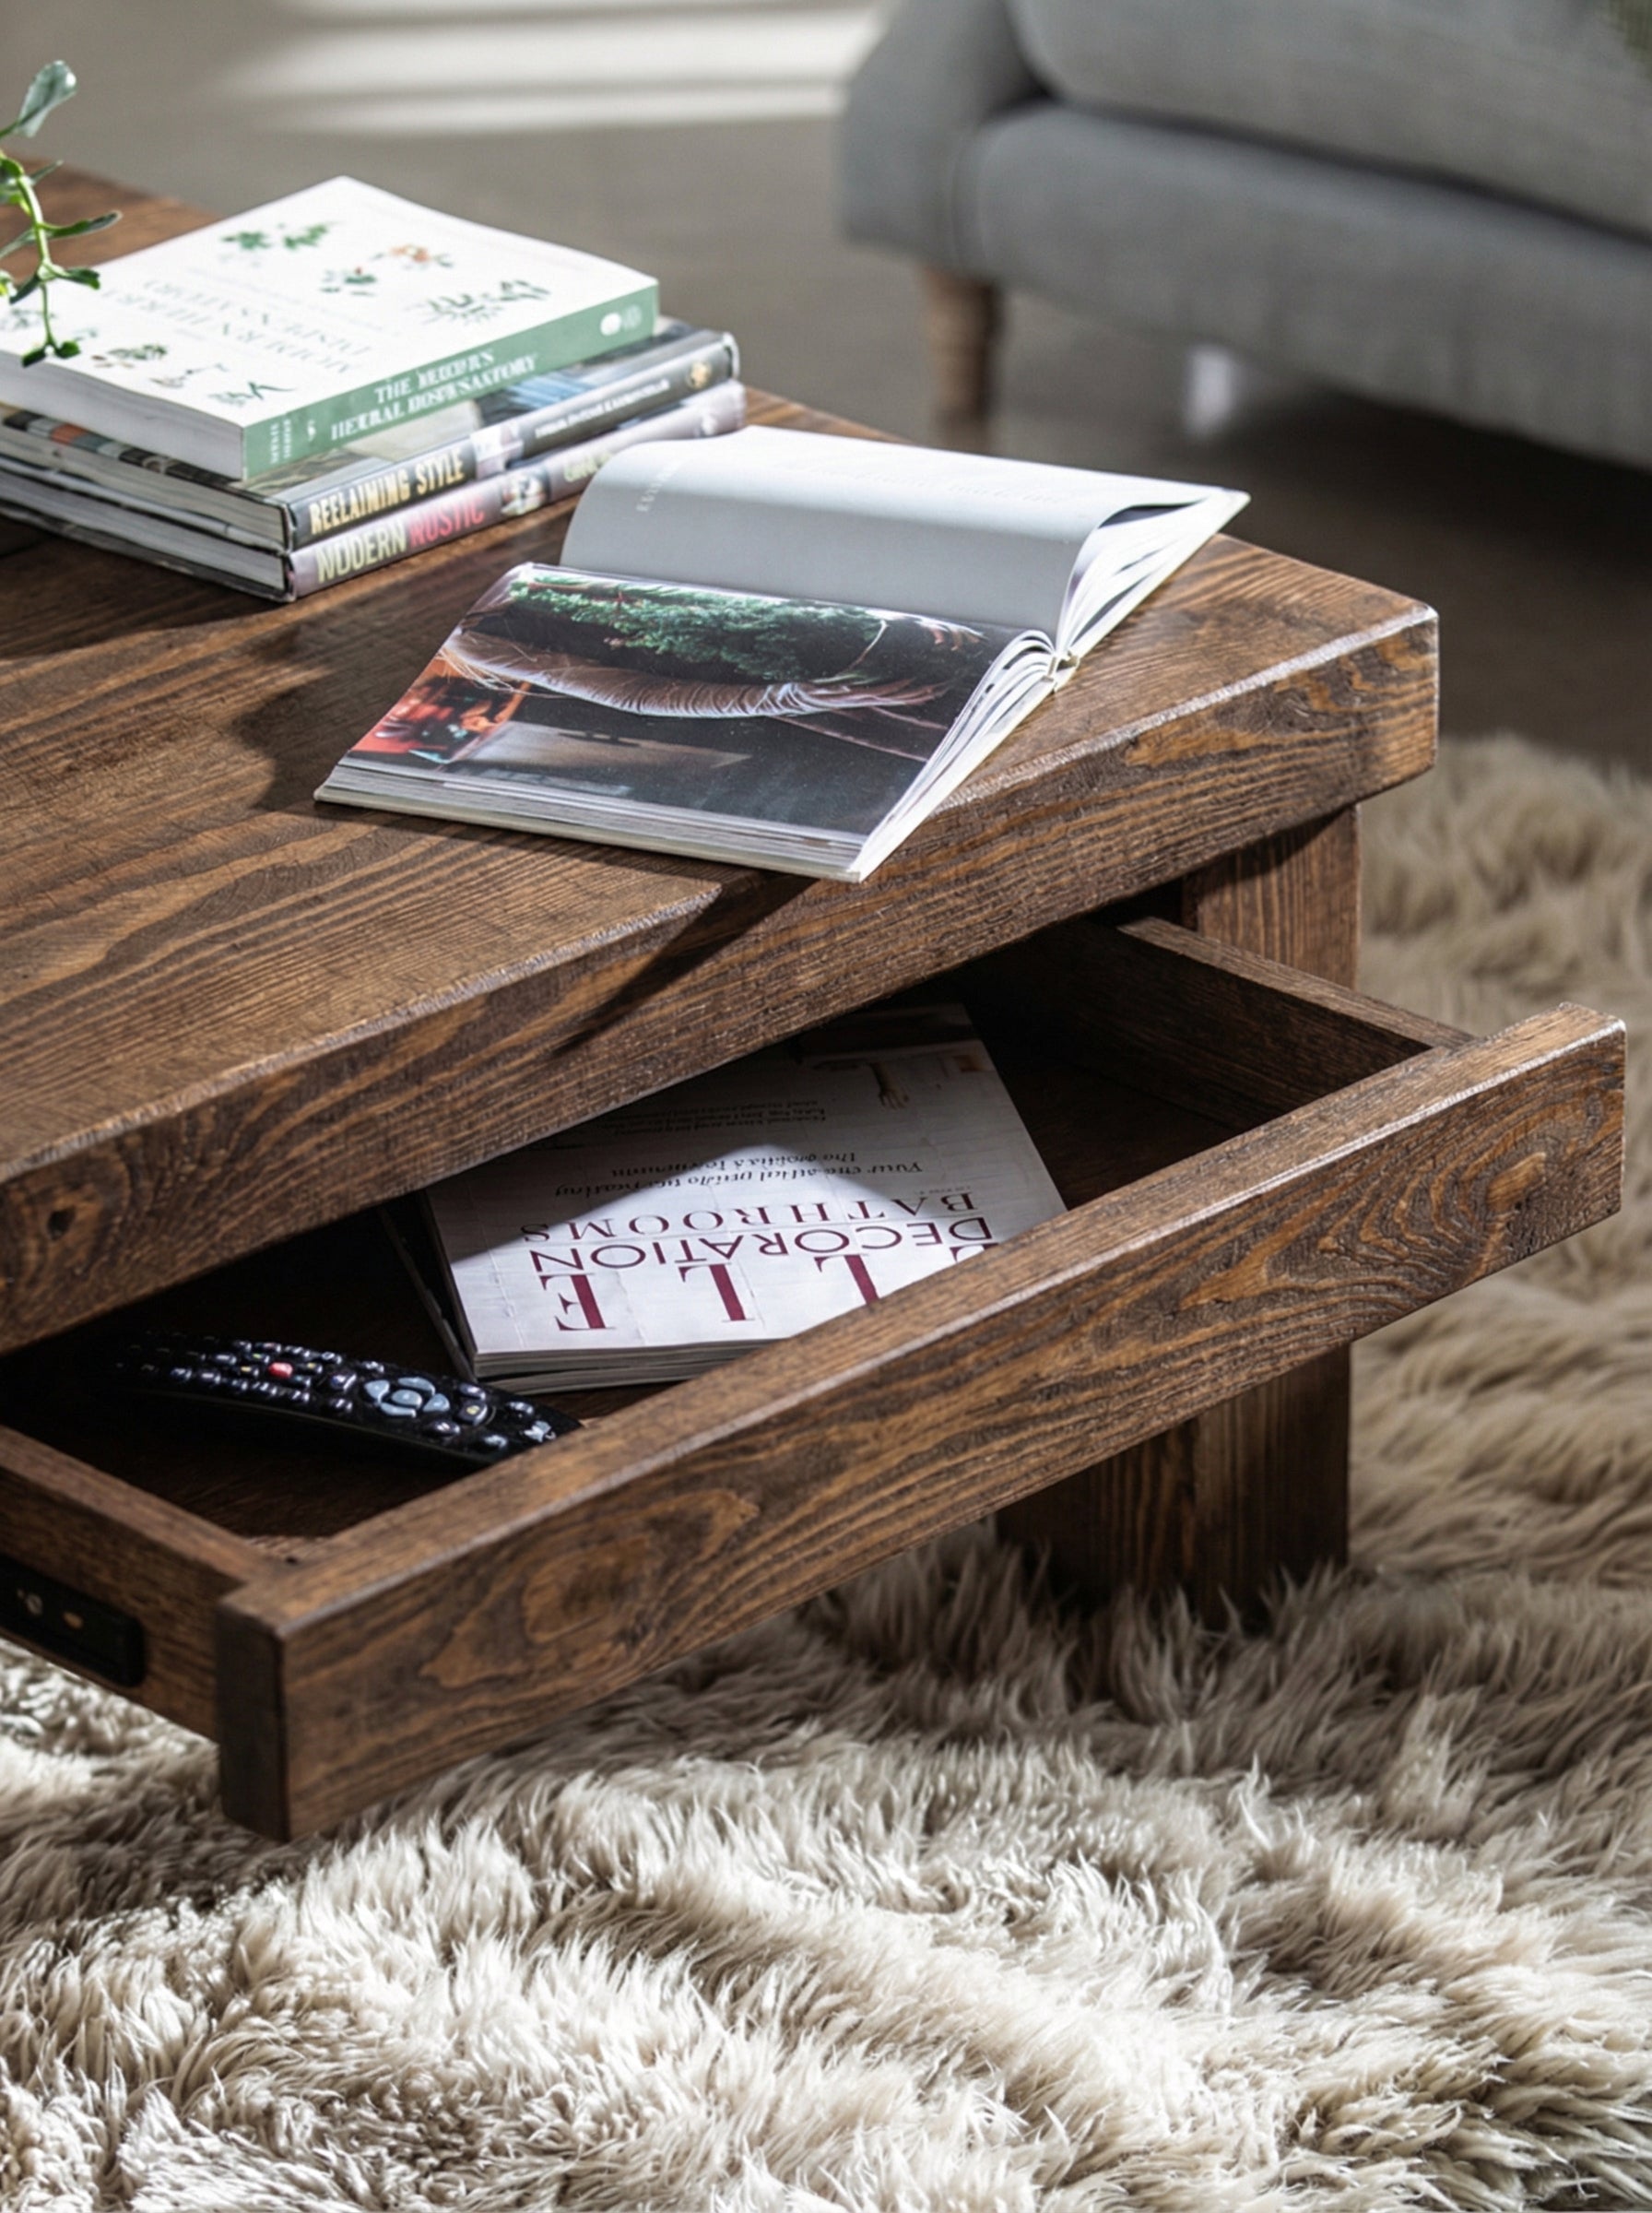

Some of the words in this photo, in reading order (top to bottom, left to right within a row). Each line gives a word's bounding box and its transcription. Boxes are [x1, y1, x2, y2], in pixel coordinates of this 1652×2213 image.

[373, 377, 413, 404] THE
[416, 448, 465, 495] STYLE
[520, 1192, 978, 1243] BATHROOMS
[528, 1216, 993, 1272] DECORATION
